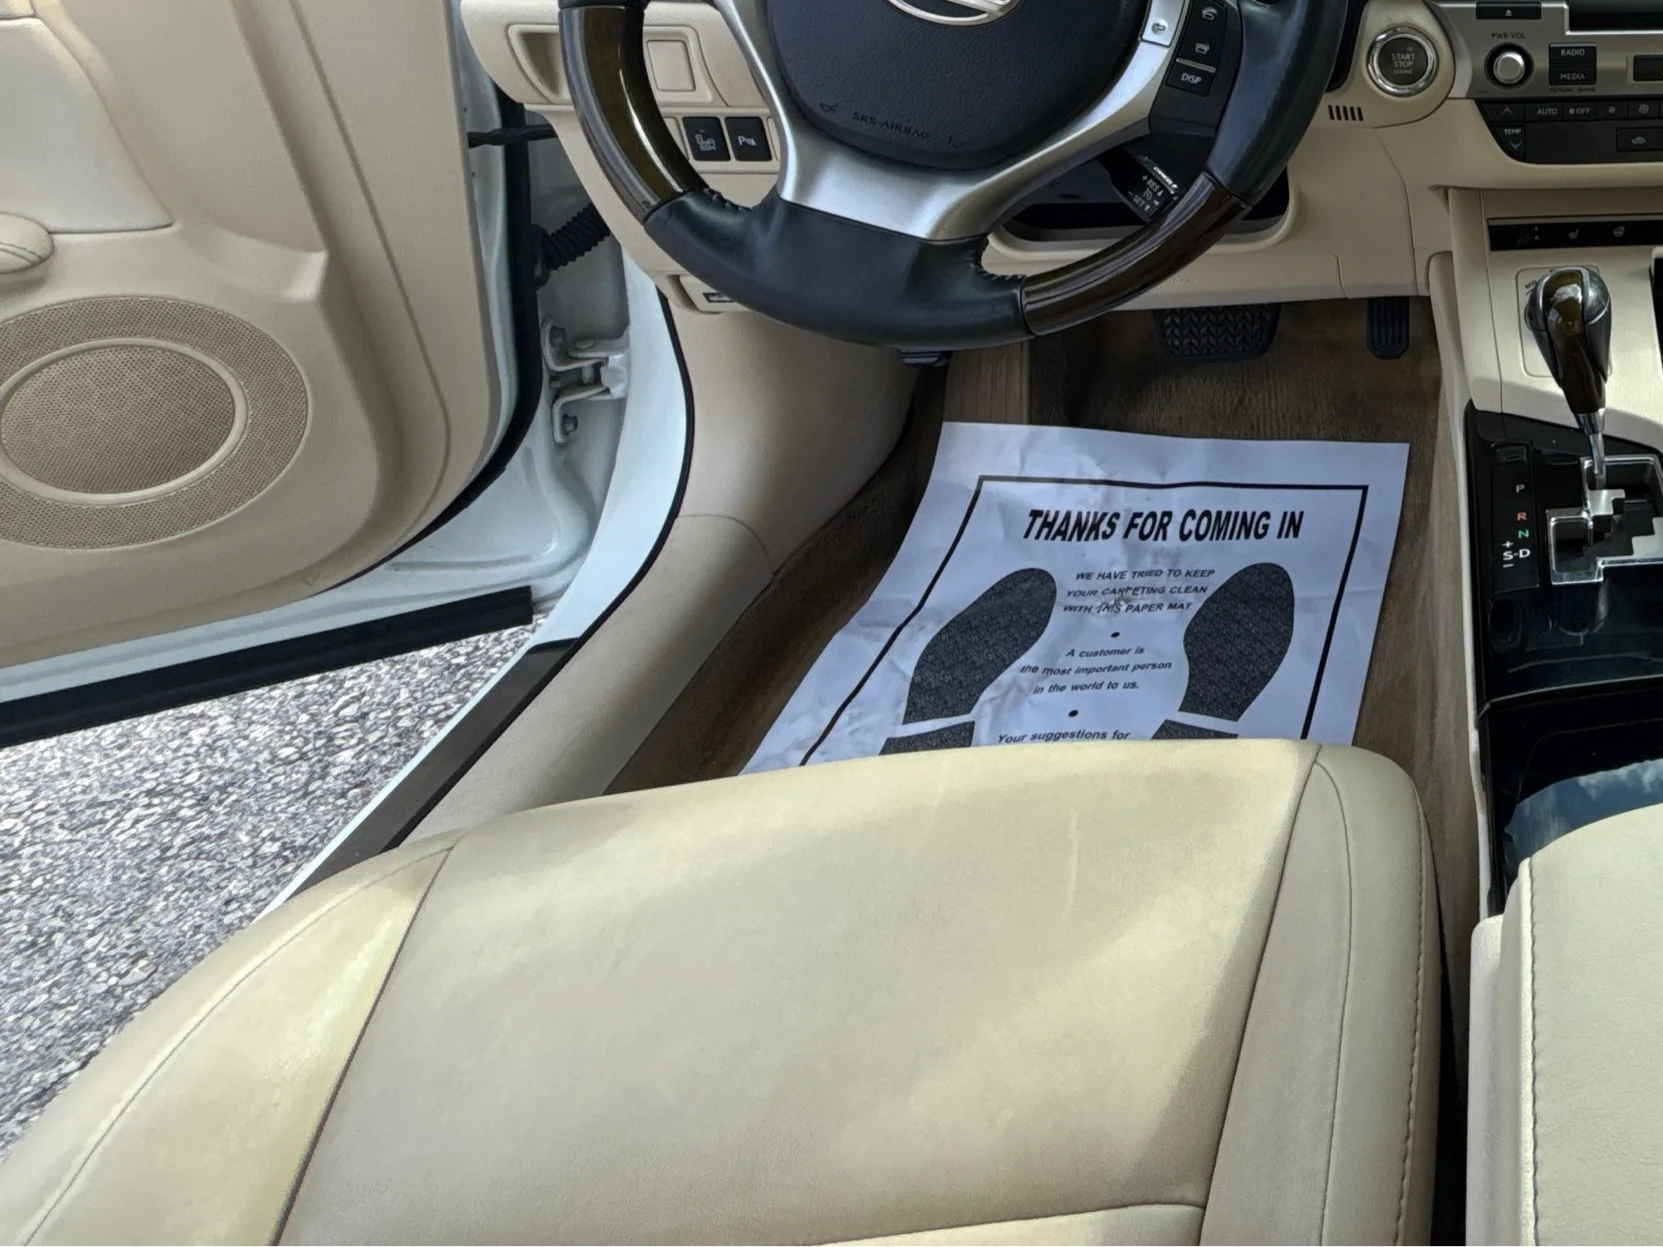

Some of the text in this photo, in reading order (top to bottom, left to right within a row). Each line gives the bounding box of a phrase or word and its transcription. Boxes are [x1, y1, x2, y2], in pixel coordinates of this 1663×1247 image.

[1391, 52, 1416, 61] START
[1560, 48, 1585, 56] RADIO
[1393, 61, 1414, 69] STOP
[1181, 73, 1203, 85] DISP
[1560, 73, 1585, 81] MEDIA
[1537, 107, 1558, 116] AUTO
[1576, 107, 1591, 115] OFF
[1503, 128, 1522, 136] TEMP
[1515, 484, 1526, 493] P
[1516, 512, 1528, 521] R
[1023, 509, 1304, 542] THANKS FOR COMING IN
[1517, 529, 1530, 539] N
[1075, 568, 1216, 581] WE HAVE TRIED TO KEEP
[1066, 585, 1209, 598] YOUR CARPETING CLEAN
[1063, 602, 1194, 615] WITH THIS PAPER MAT
[1065, 646, 1145, 658] A customer is
[1020, 661, 1173, 677] the most important person
[1032, 680, 1140, 695] in the world to us.
[998, 729, 1132, 744] Your suggestions for
